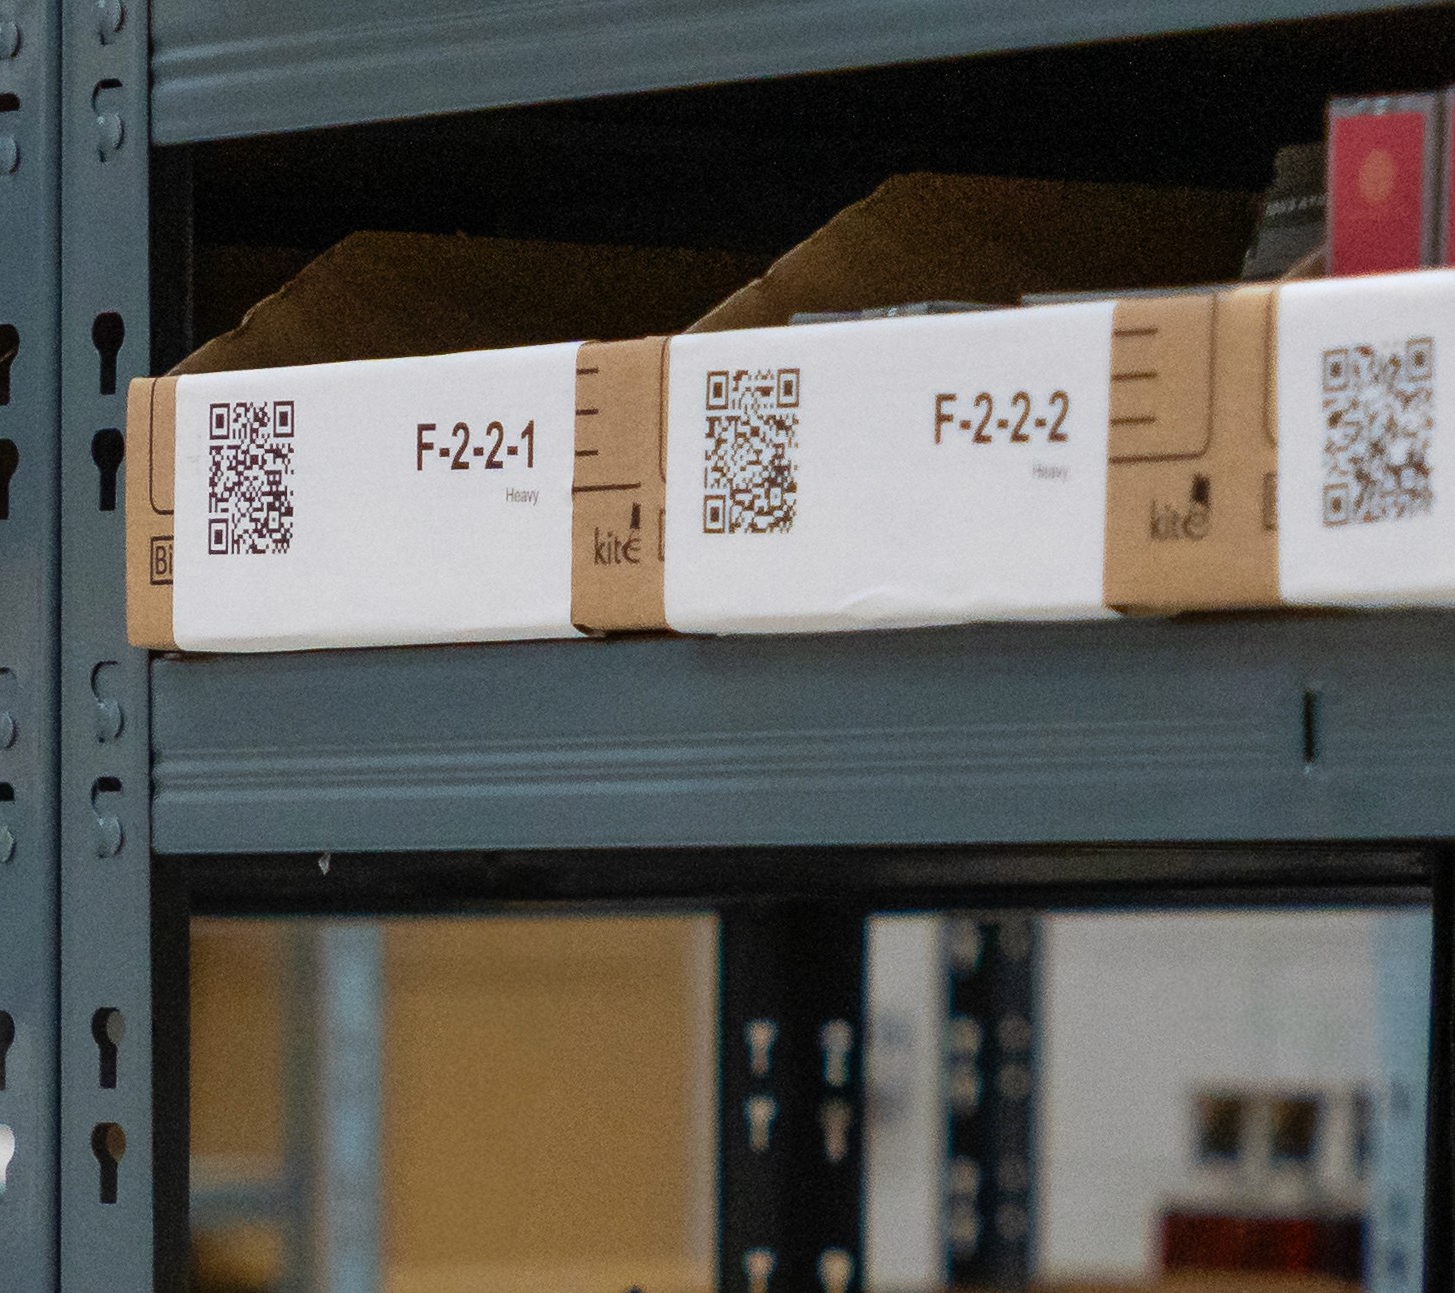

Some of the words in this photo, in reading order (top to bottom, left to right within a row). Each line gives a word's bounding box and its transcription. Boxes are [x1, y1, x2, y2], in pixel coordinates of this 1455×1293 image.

[934, 390, 1071, 444] F-2-2-2
[416, 420, 535, 471] F-2-2-1
[505, 488, 539, 504] Heavy
[155, 544, 174, 576] Bi
[592, 525, 643, 567] kite
